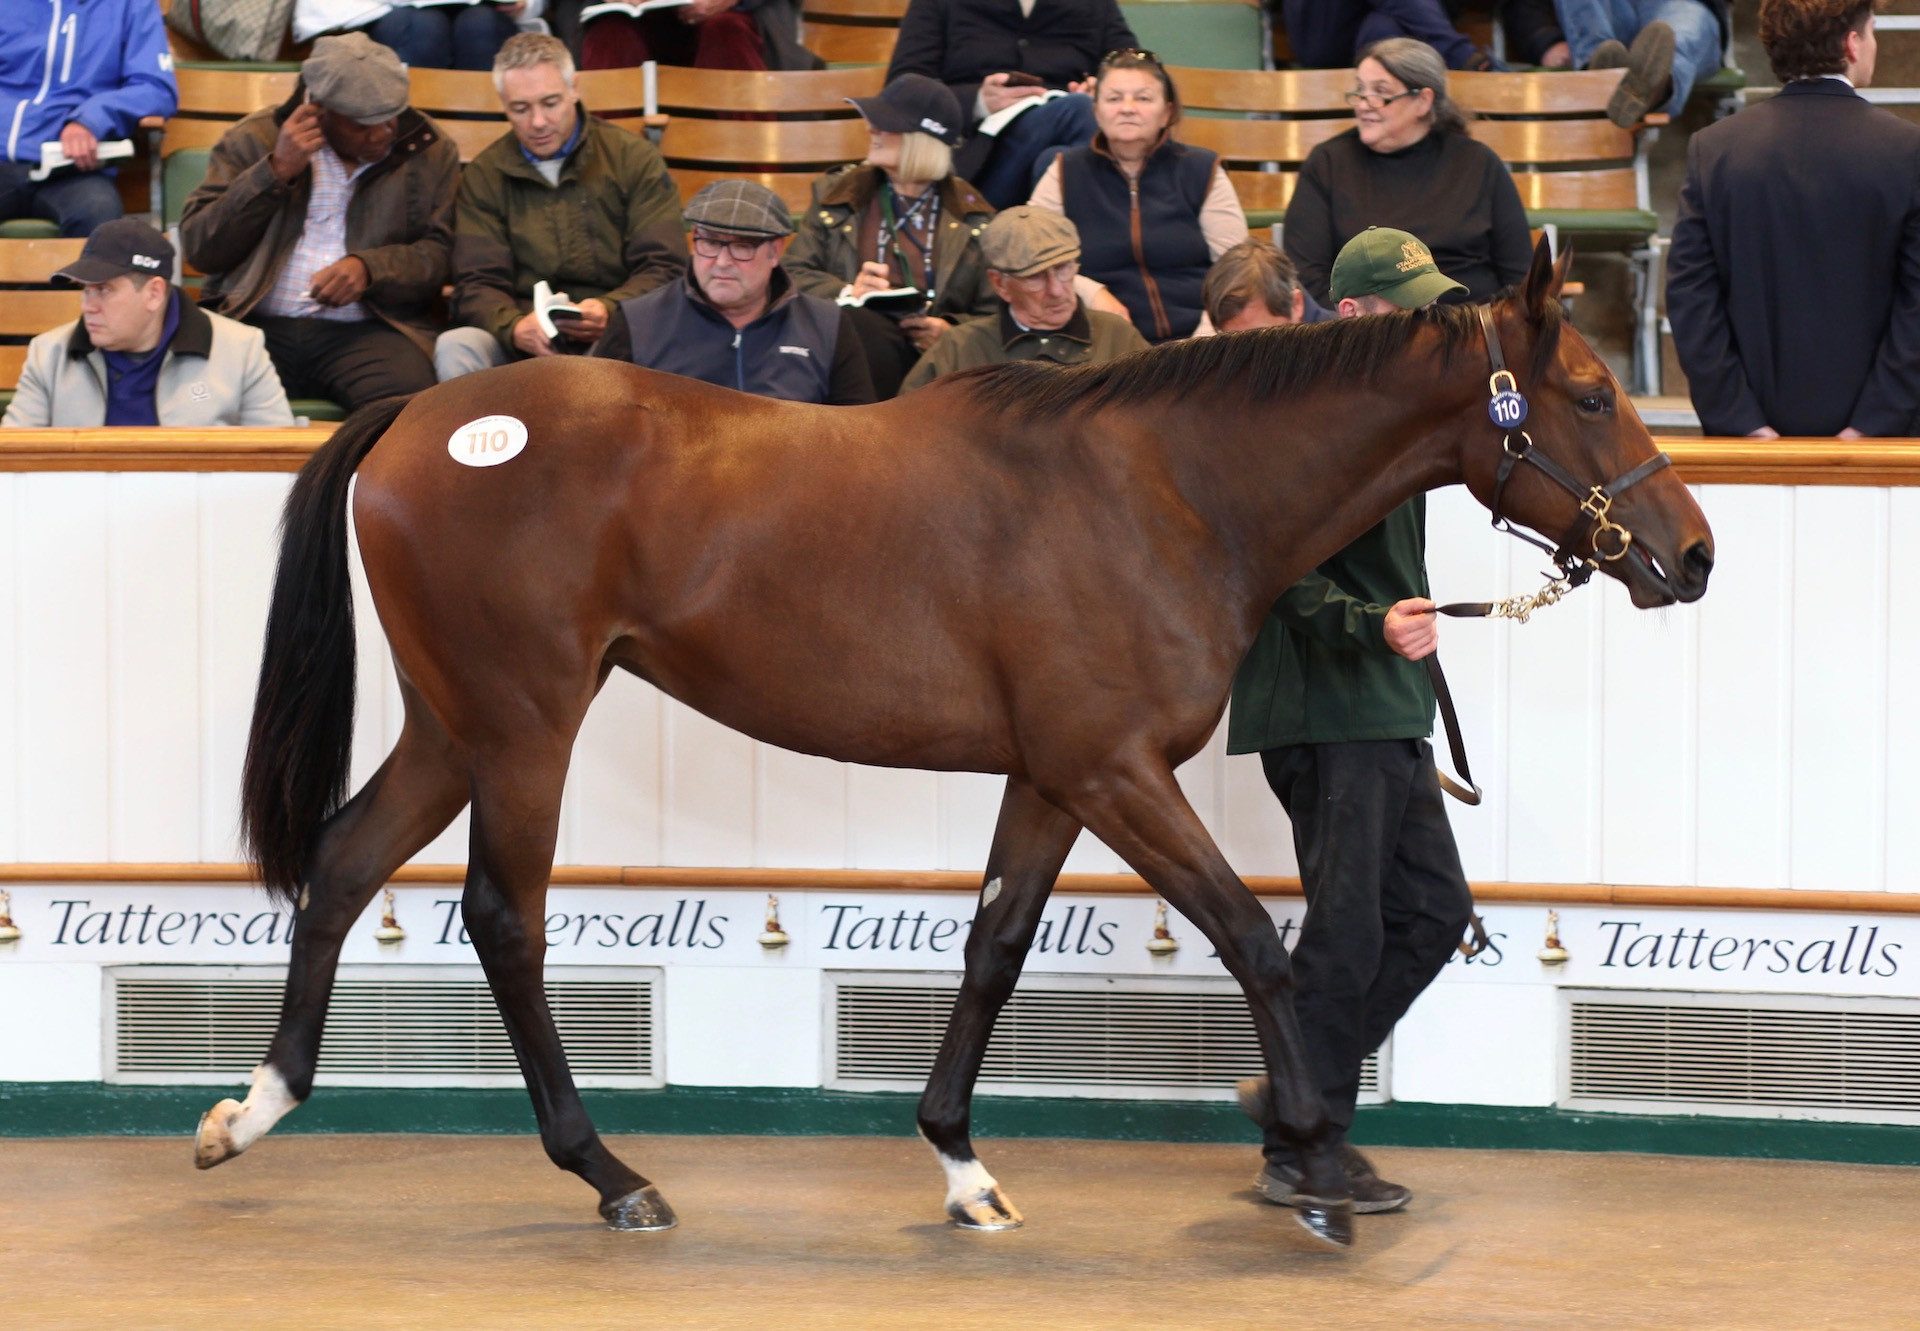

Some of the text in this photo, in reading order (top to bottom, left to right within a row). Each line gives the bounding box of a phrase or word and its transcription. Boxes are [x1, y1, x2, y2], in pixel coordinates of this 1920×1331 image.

[1495, 399, 1520, 422] 110
[467, 430, 509, 454] 110
[432, 899, 729, 949] Tersalls
[1599, 921, 1902, 977] Tattersalls
